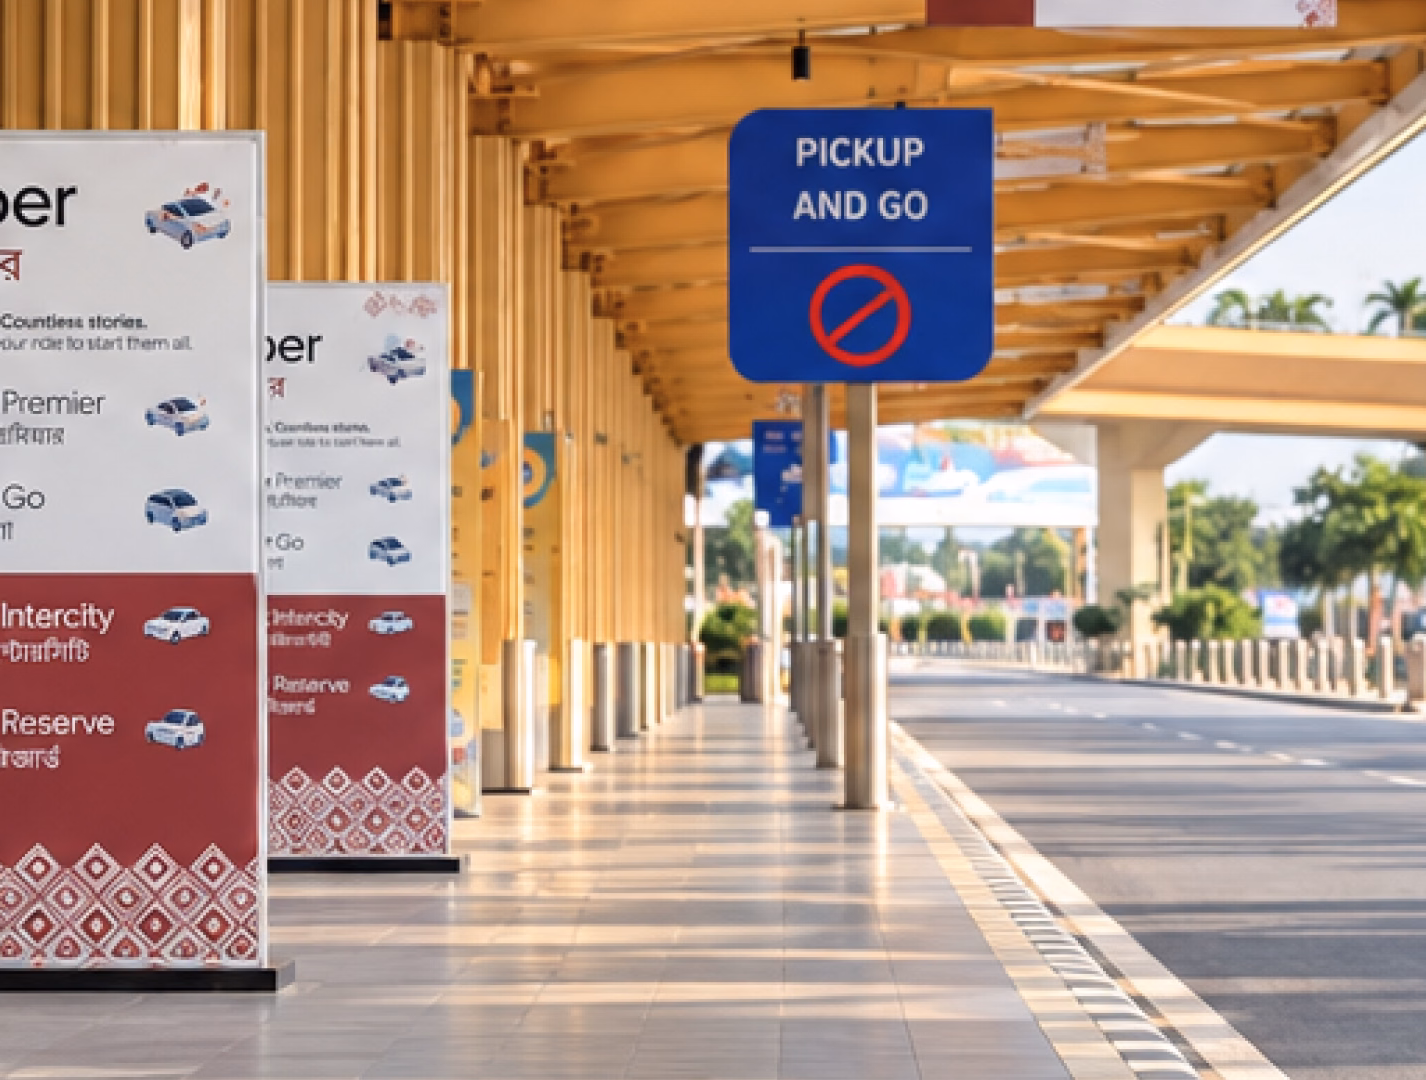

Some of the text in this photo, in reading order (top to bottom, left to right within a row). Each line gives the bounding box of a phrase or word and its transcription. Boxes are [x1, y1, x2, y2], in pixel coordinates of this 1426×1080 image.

[797, 138, 925, 166] PICKUP
[794, 191, 928, 219] AND GO
[266, 335, 323, 363] er
[3, 391, 105, 414] Premier
[3, 484, 44, 509] Go
[276, 533, 304, 550] Go
[2, 603, 114, 634] Intercity
[2, 709, 114, 734] Reserve
